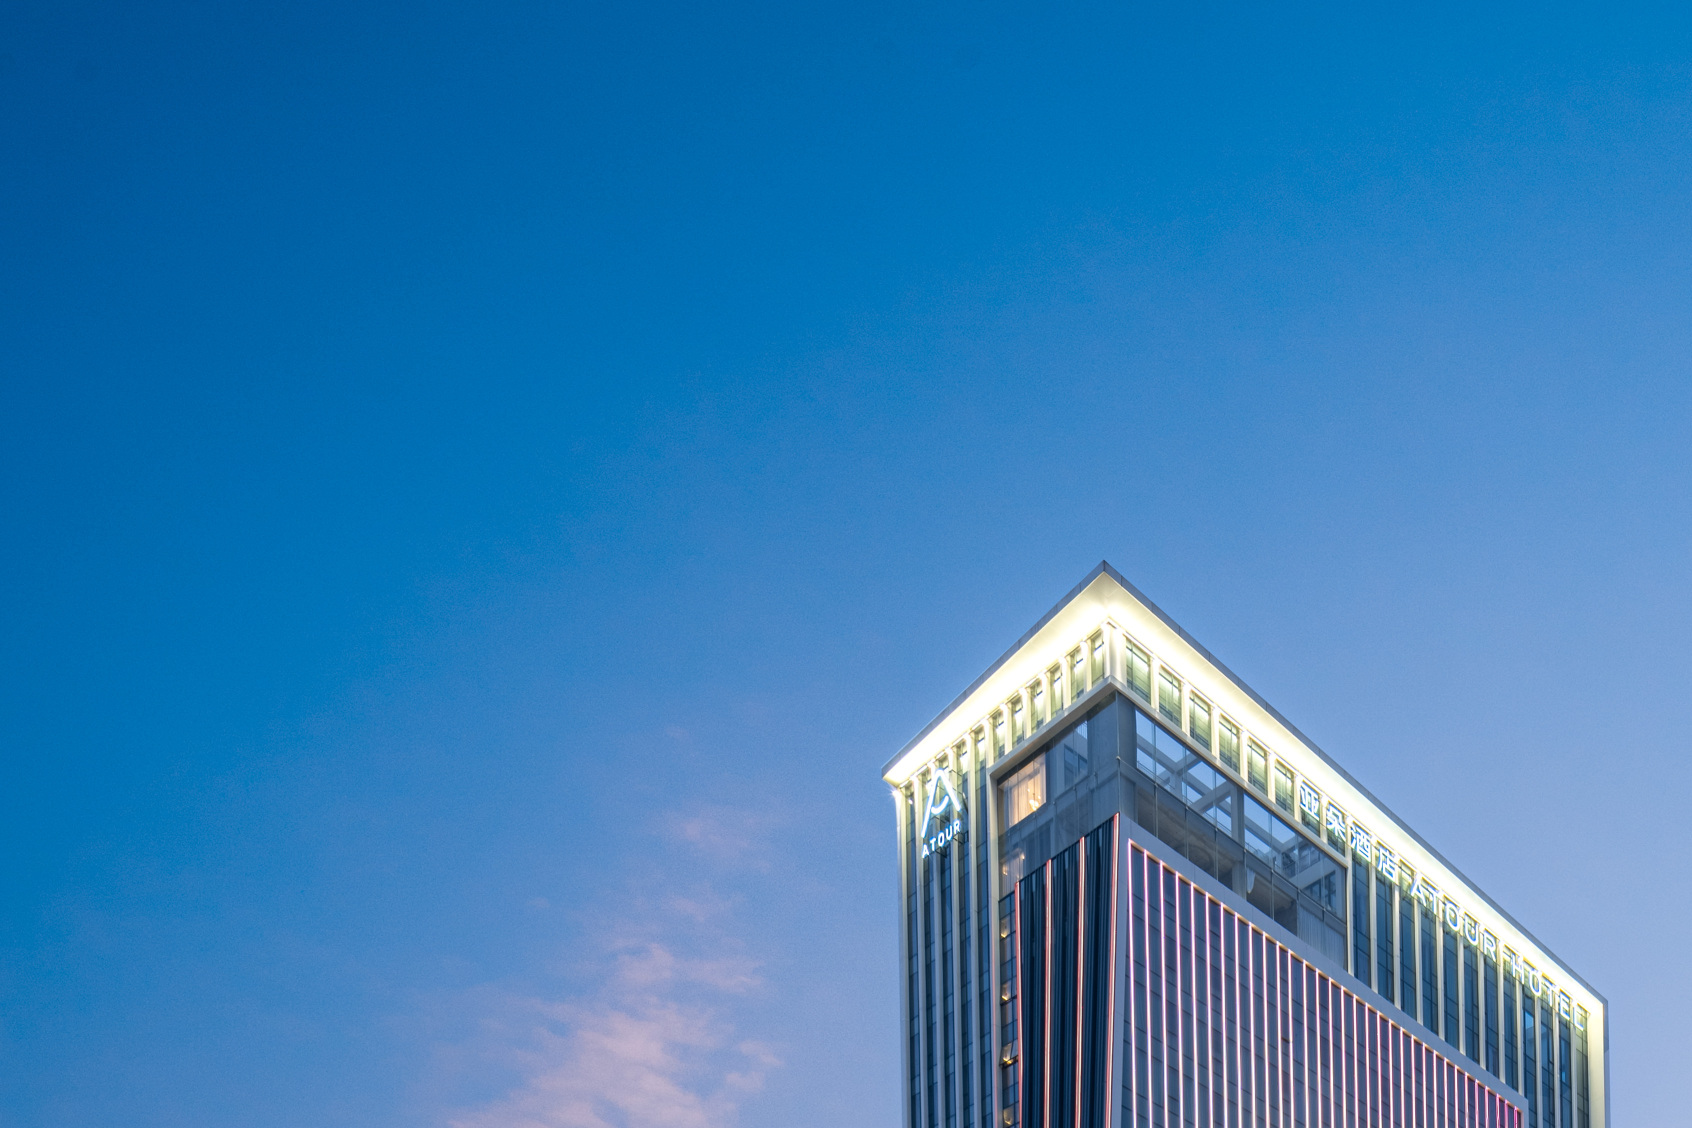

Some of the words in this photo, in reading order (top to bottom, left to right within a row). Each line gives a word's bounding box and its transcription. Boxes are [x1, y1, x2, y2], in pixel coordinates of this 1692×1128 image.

[921, 819, 960, 858] ATOUR
[1300, 780, 1397, 880] 亚朵酒店
[1410, 873, 1497, 961] ATOUR
[1511, 952, 1584, 1031] HOTEL
